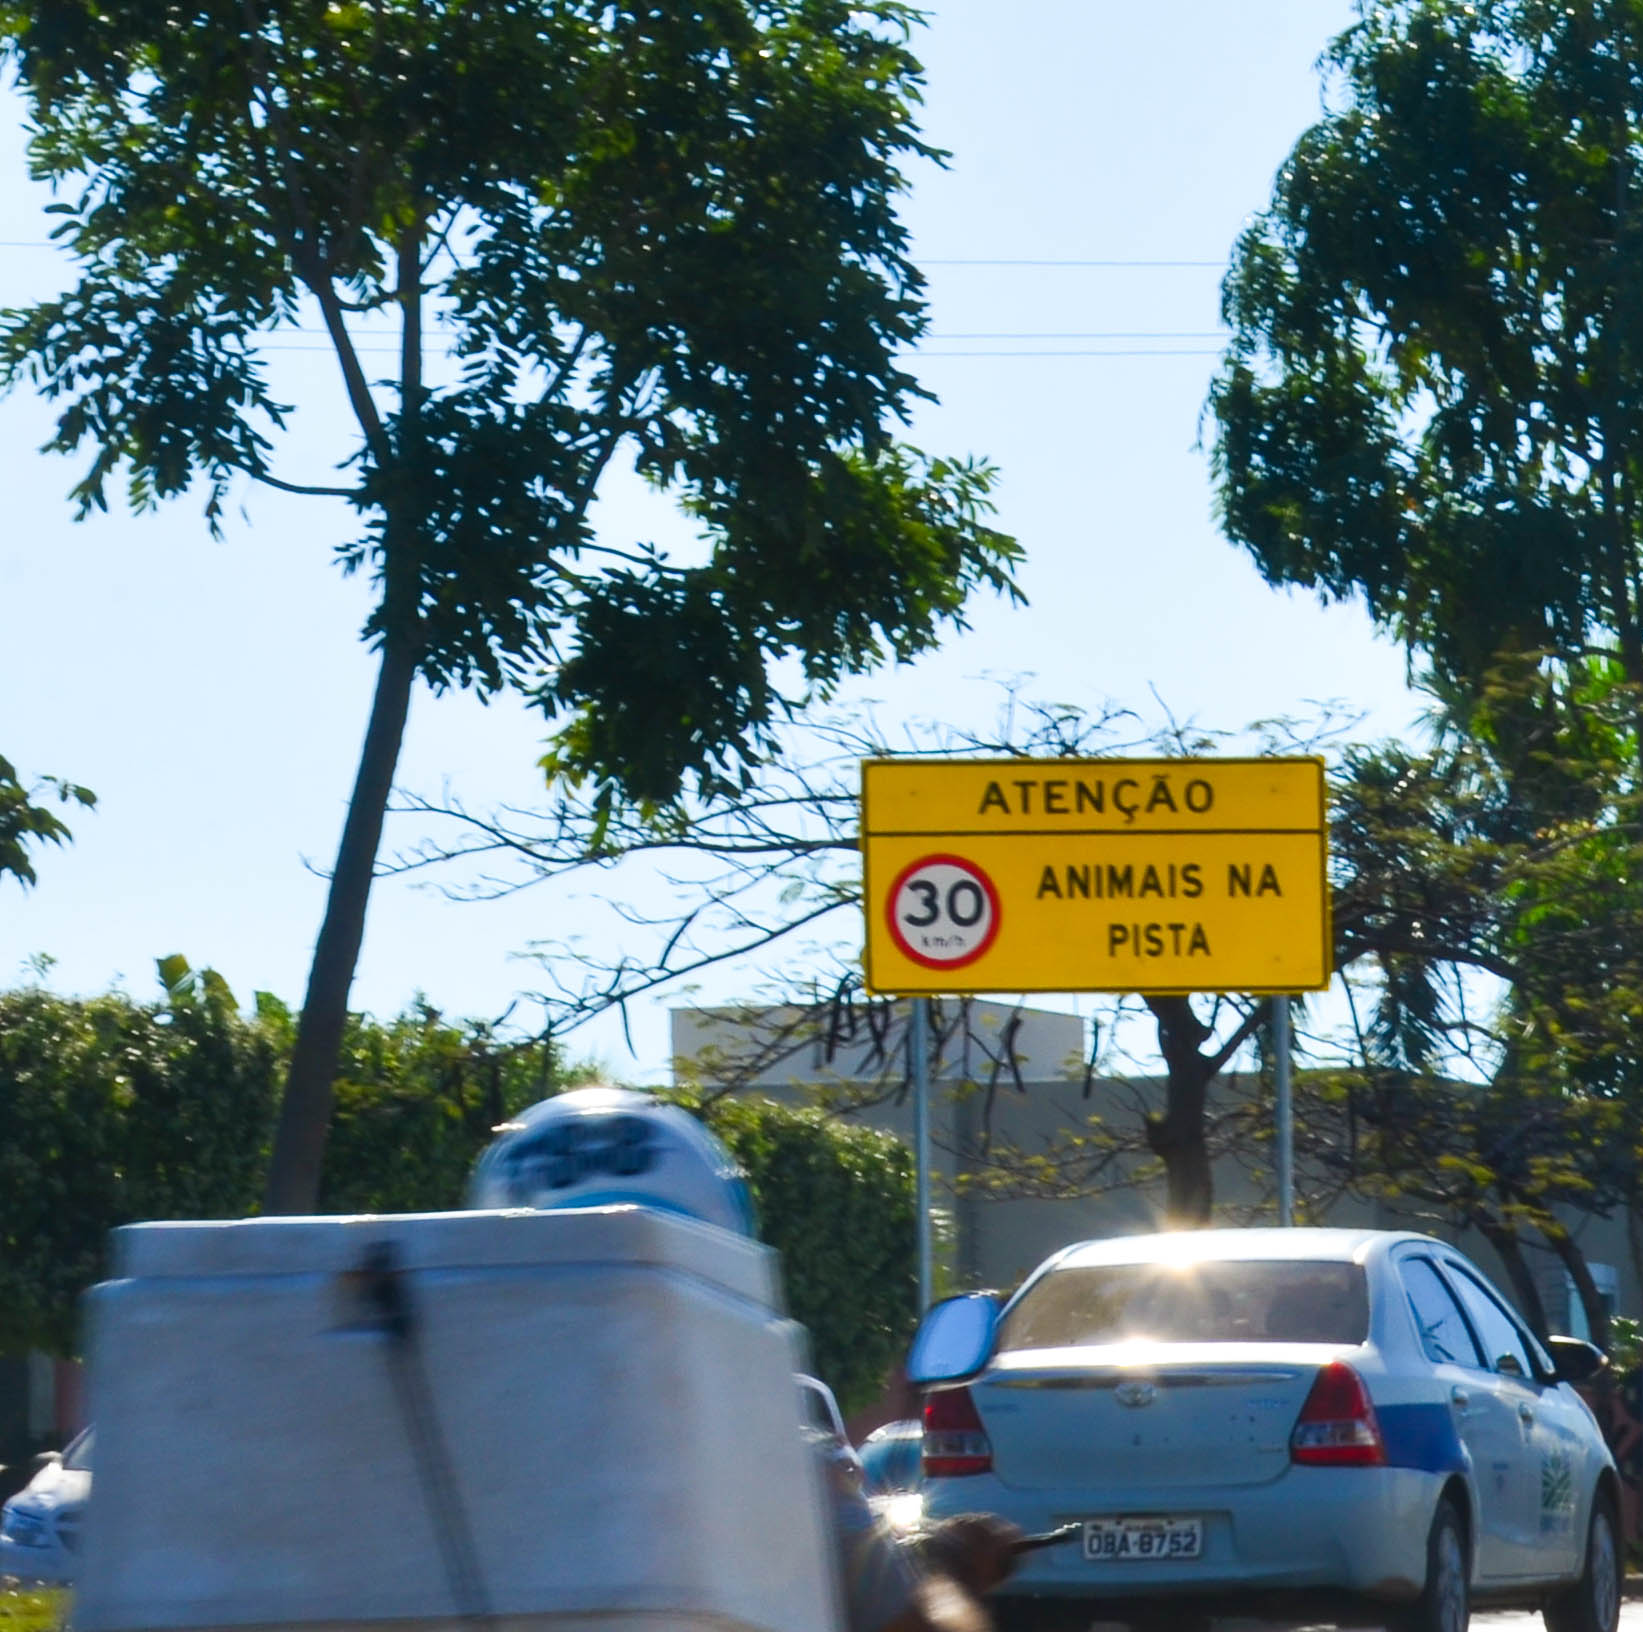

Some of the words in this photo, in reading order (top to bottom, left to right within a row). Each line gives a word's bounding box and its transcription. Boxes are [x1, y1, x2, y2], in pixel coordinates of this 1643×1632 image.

[977, 775, 1216, 824] ATENÇÃO
[1036, 863, 1203, 899] ANIMAIS
[1227, 862, 1283, 898] NA
[903, 879, 984, 928] 30
[1108, 922, 1212, 958] PISTA
[1088, 1532, 1197, 1555] OBA-8752
